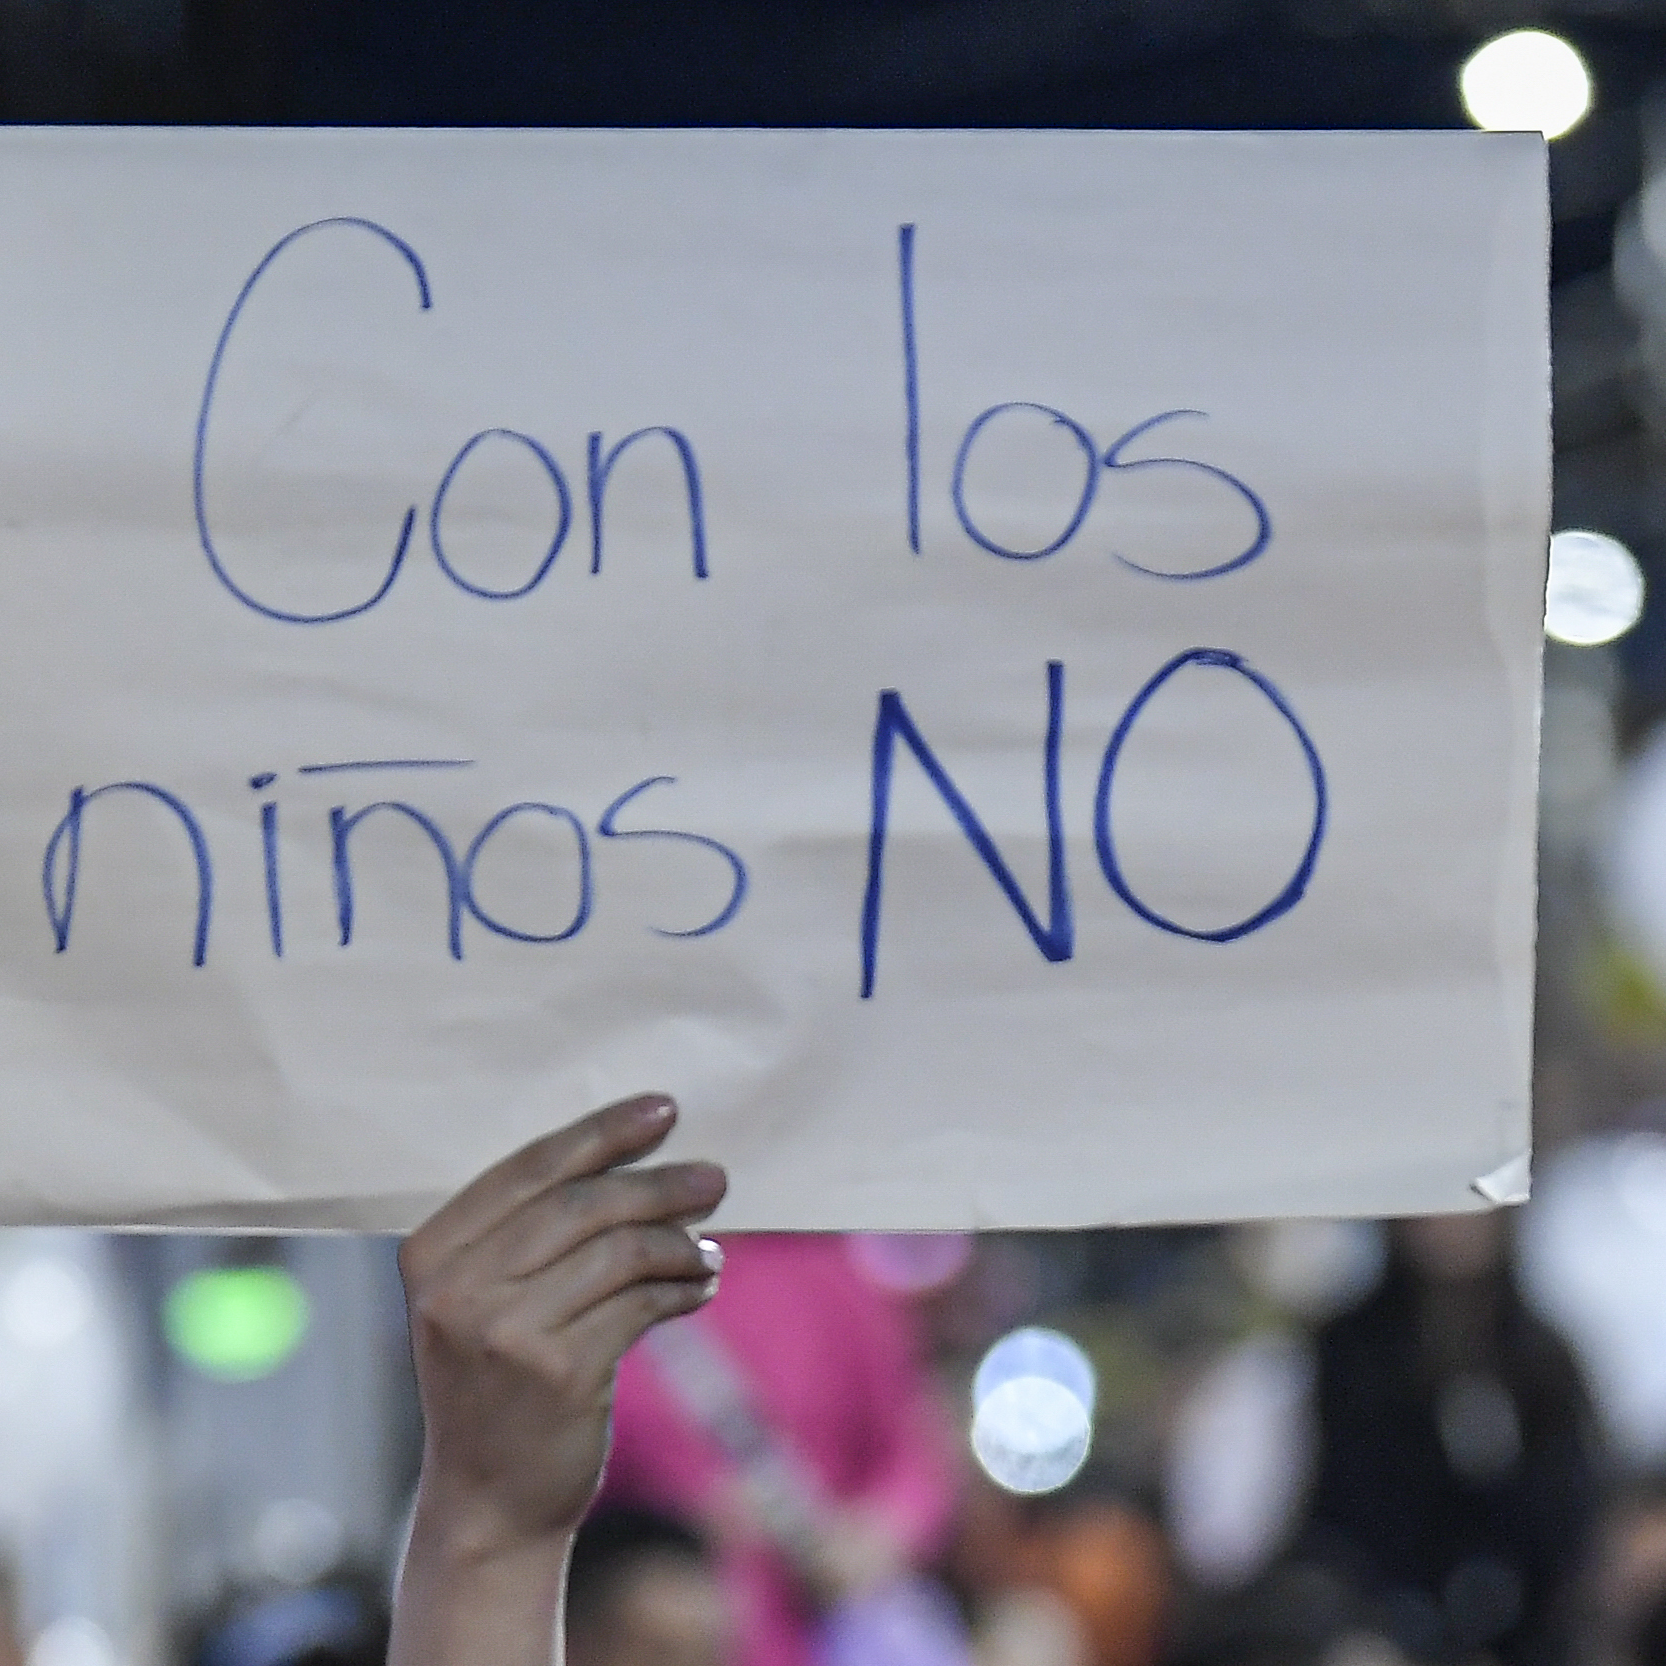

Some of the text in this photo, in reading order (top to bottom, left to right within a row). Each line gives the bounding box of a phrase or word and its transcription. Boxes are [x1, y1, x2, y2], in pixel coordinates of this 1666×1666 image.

[194, 217, 1273, 624] Con los
[42, 647, 1329, 1000] niños NO
